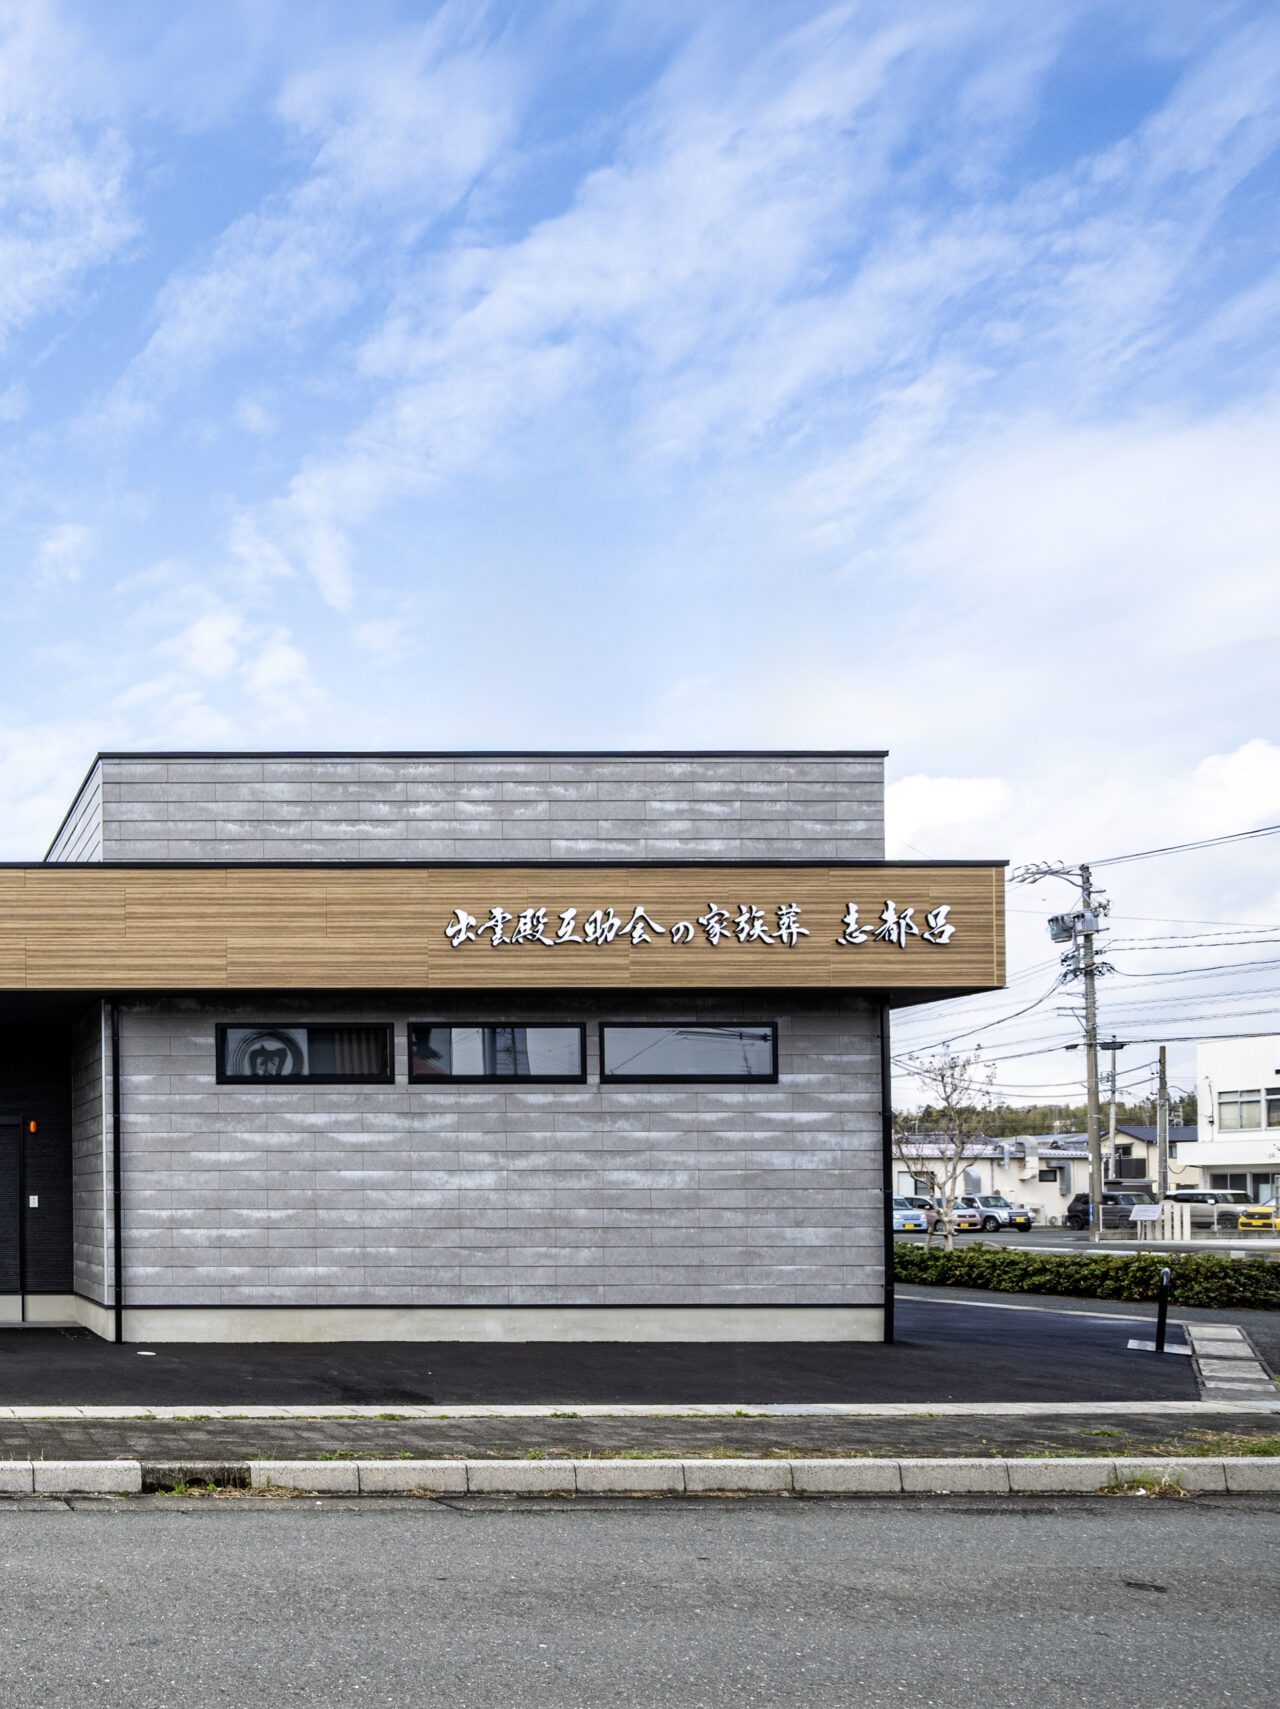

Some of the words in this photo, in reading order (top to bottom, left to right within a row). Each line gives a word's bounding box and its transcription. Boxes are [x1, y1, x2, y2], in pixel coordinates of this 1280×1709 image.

[444, 902, 810, 948] 出雲殿互助会の家族葬
[835, 899, 957, 949] 志都呂
